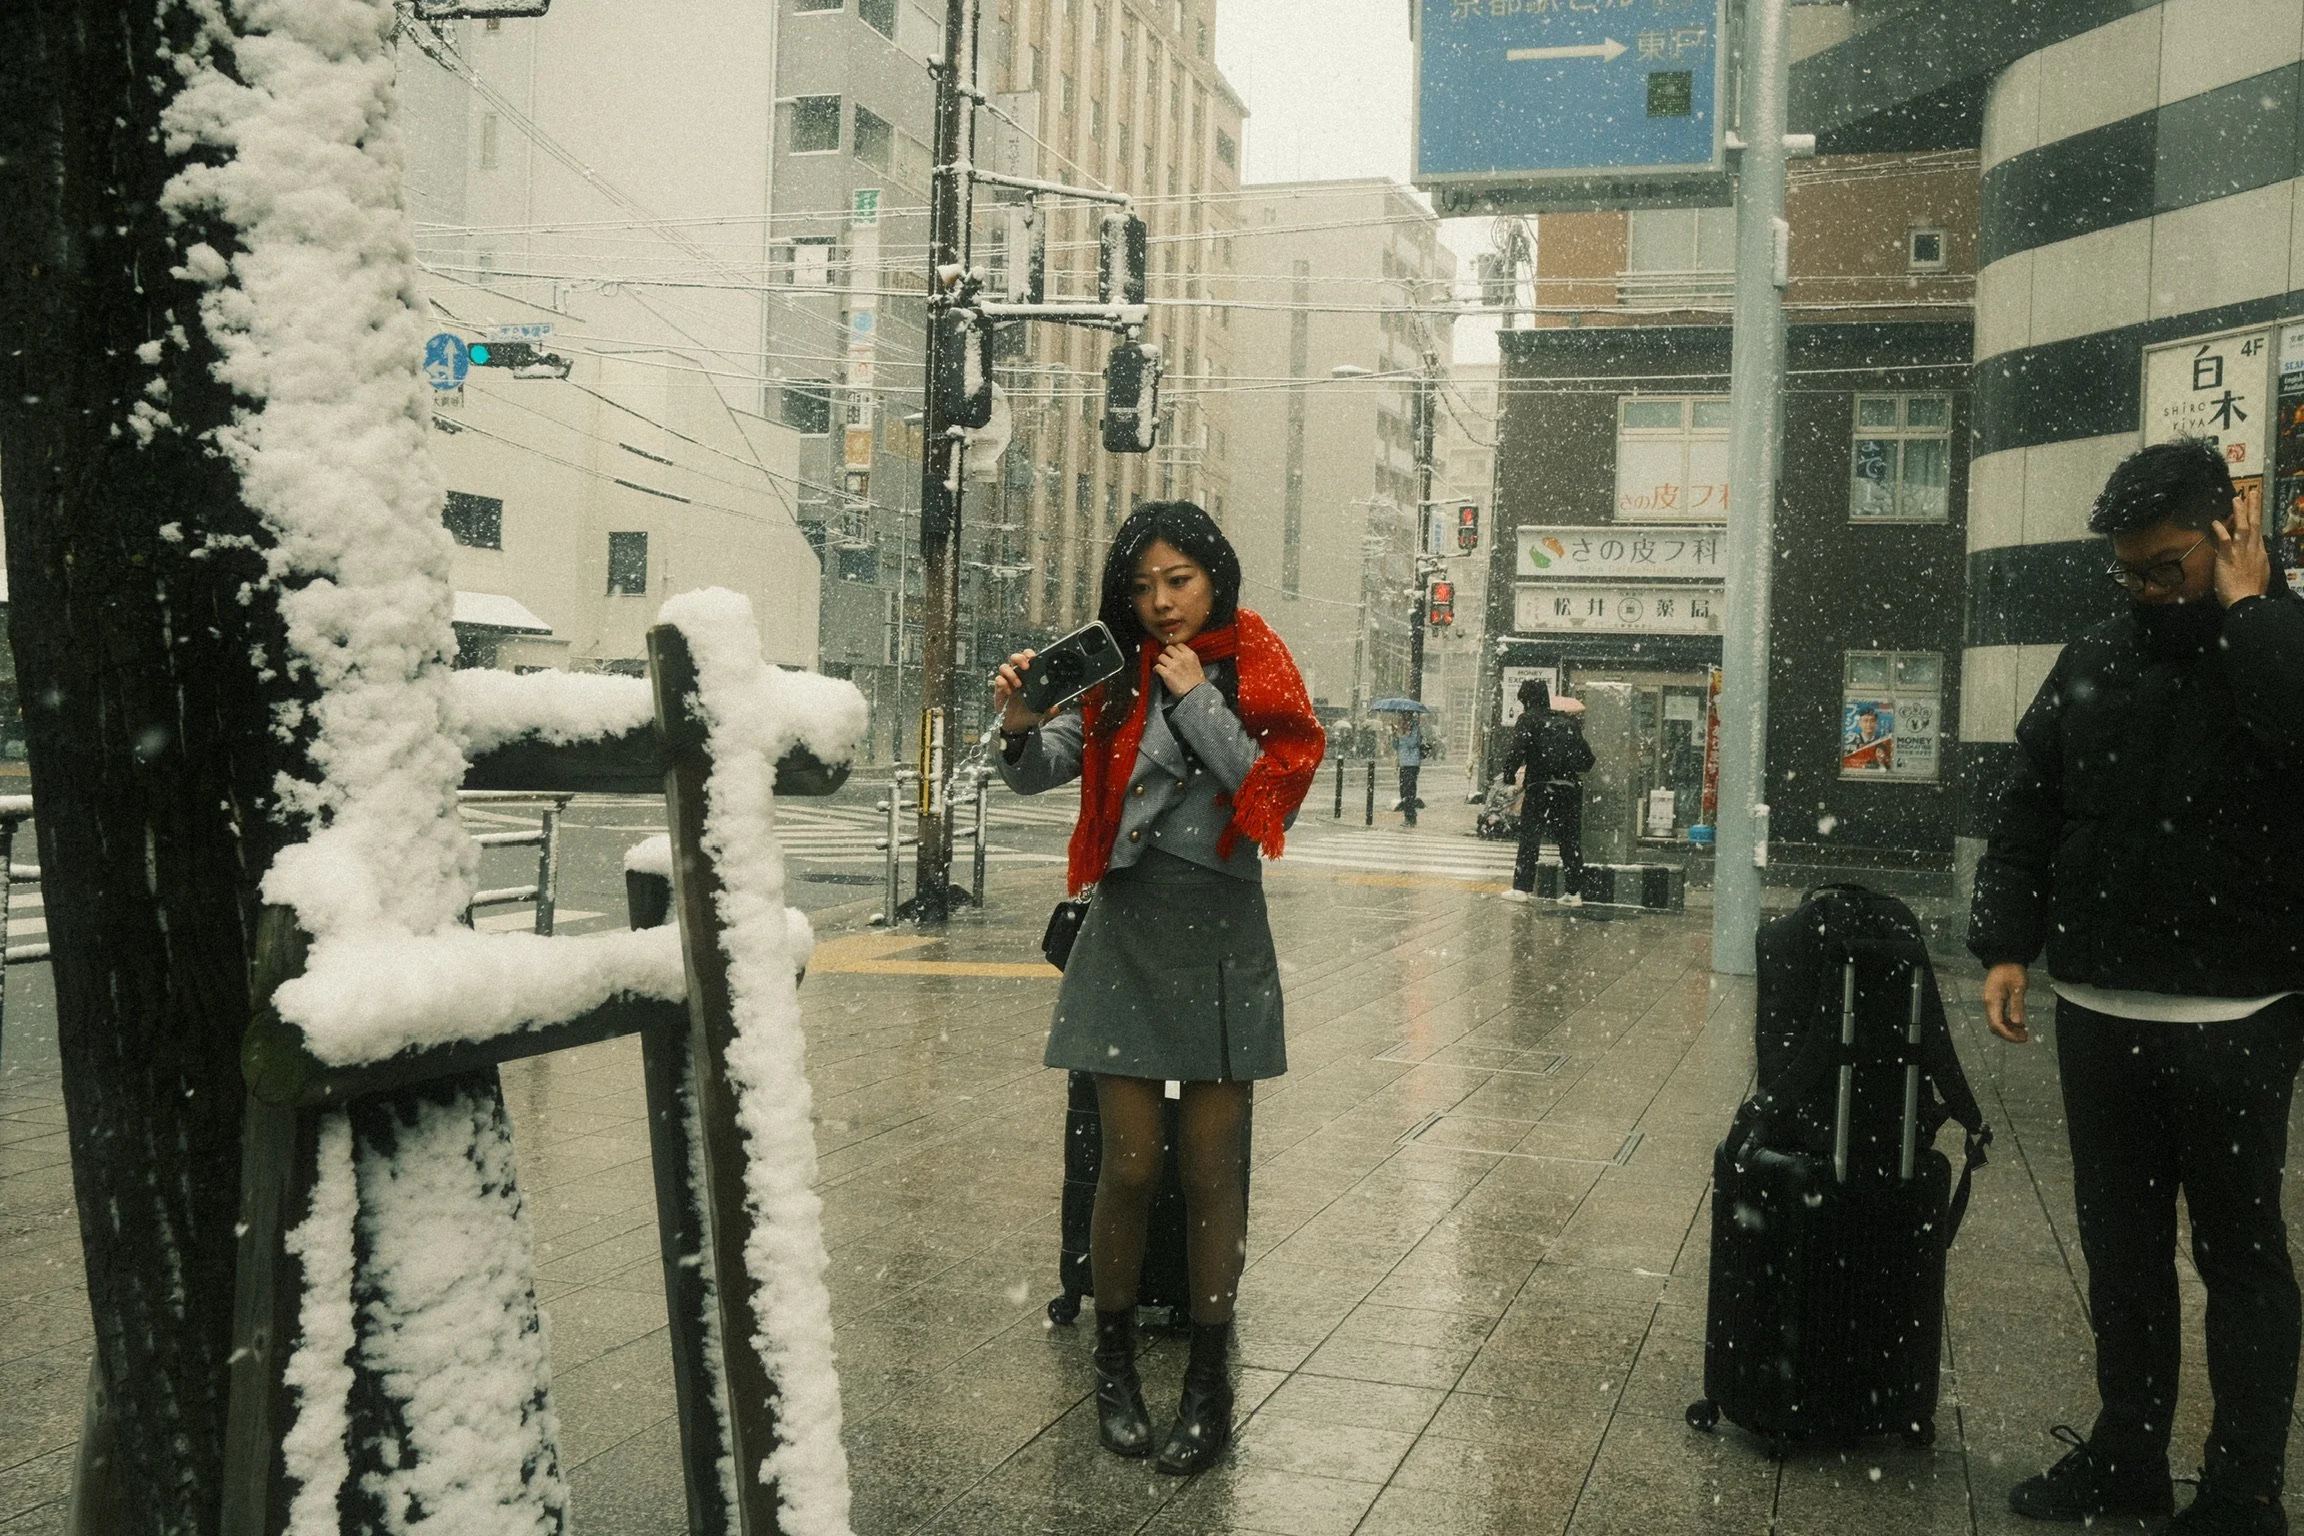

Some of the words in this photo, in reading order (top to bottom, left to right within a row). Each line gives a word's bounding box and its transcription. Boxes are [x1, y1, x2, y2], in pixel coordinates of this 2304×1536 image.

[2241, 338, 2264, 356] 4F
[2193, 345, 2248, 447] 白木
[1572, 538, 1717, 564] さの皮フ科
[1896, 737, 1932, 745] MONEY
